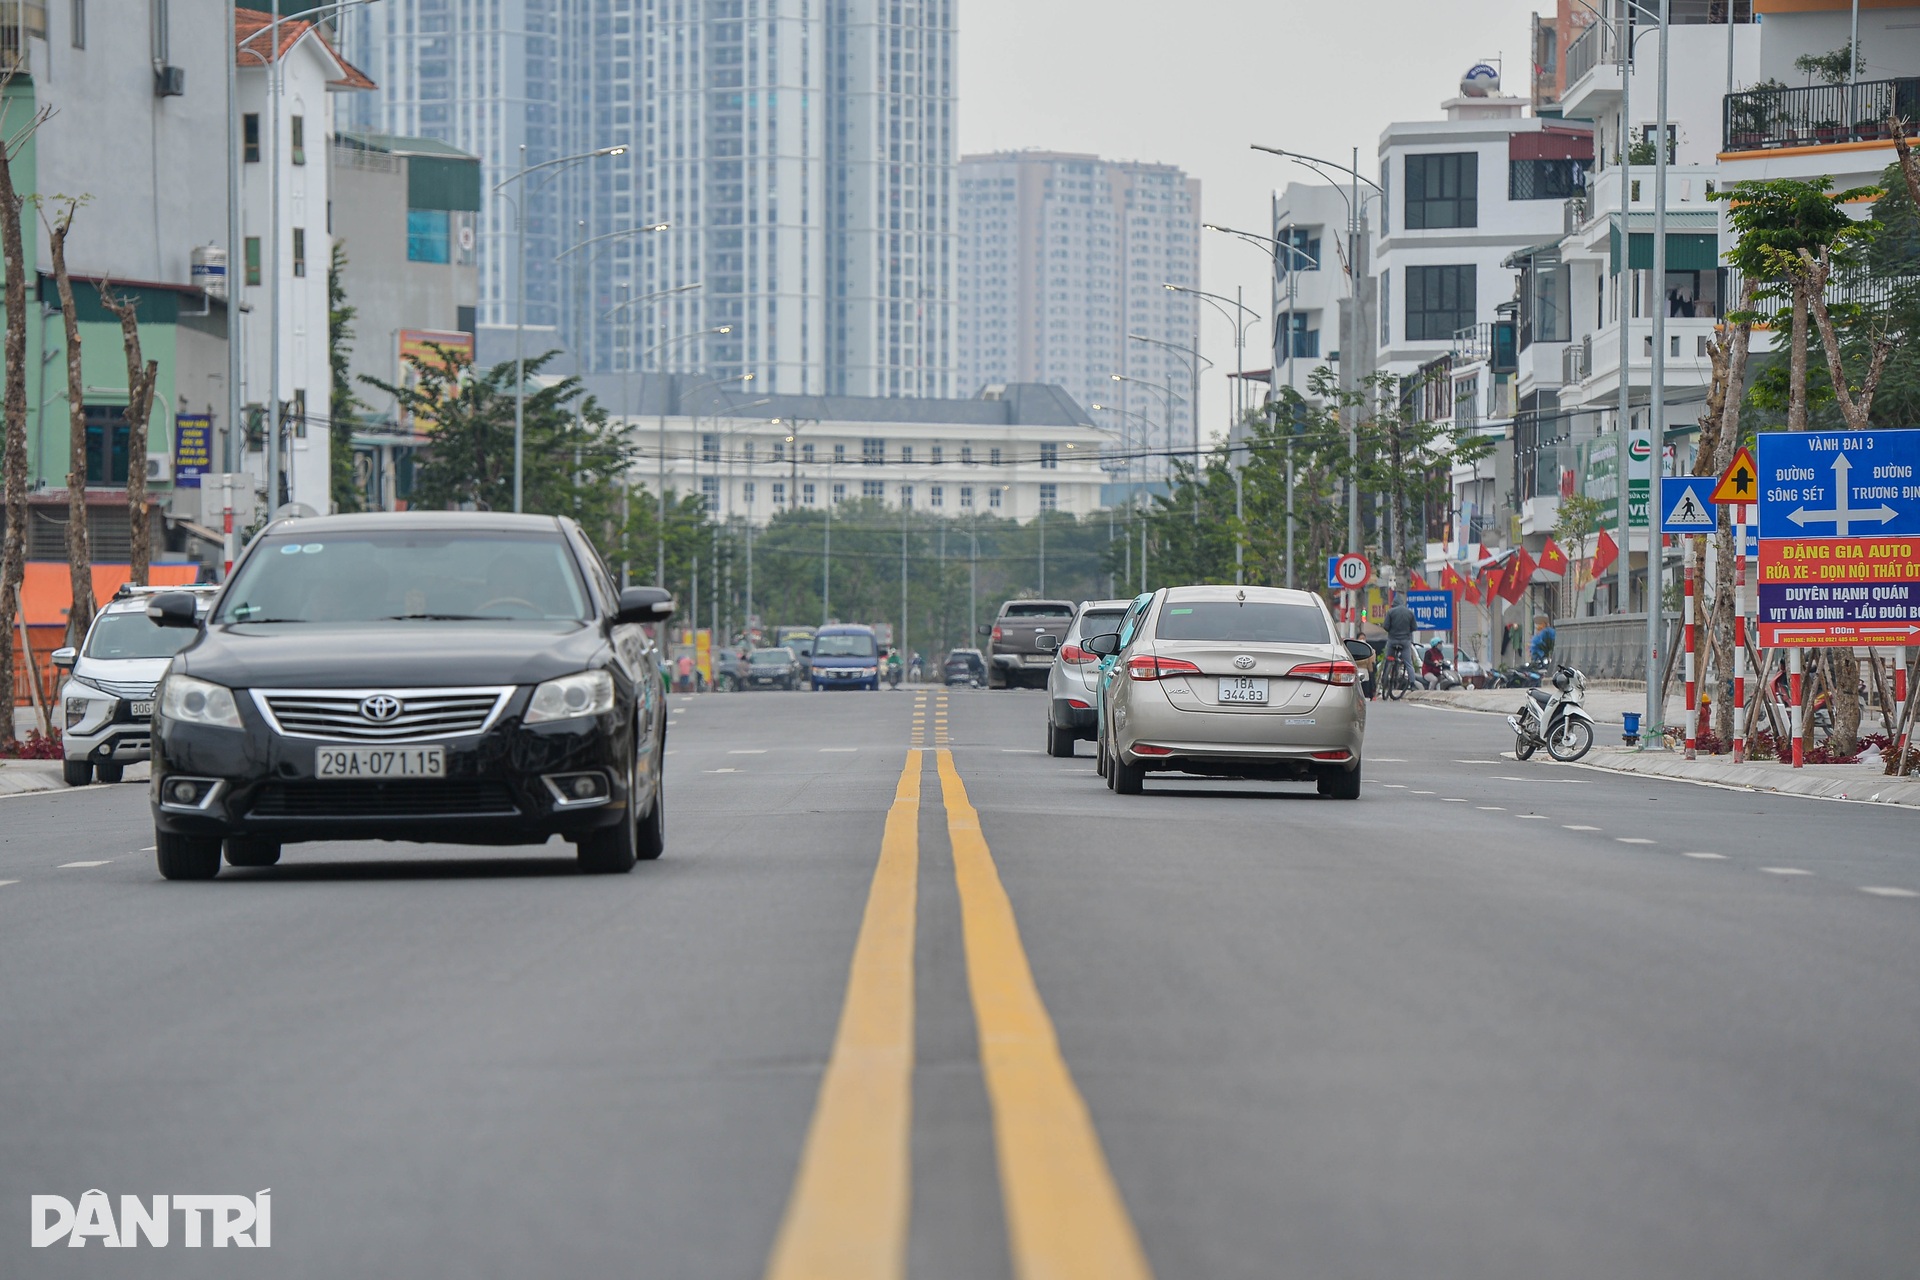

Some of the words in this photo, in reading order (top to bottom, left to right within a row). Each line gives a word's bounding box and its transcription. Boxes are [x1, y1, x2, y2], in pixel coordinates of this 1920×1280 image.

[1808, 436, 1838, 451] VÀNH
[1843, 438, 1862, 450] ĐAI
[1866, 438, 1874, 450] 3
[1776, 465, 1814, 481] ĐƯỜNG
[1873, 462, 1912, 478] ĐƯỜNG
[1767, 487, 1798, 502] SÔNG
[1802, 486, 1824, 501] SÉT
[1852, 486, 1898, 499] TRƯƠNG
[1783, 544, 1830, 562] ĐẶNG
[1836, 545, 1864, 558] GIA
[1868, 544, 1912, 558] AUTO
[1343, 564, 1356, 578] 10
[1766, 562, 1790, 579] RỬA
[1794, 566, 1809, 579] XE
[1820, 565, 1845, 581] DỌN
[1849, 562, 1869, 580] NỘI
[1873, 560, 1902, 578] THẤT
[1786, 586, 1829, 601] DUYÊN
[1832, 587, 1869, 602] HẠNH
[1872, 585, 1908, 601] QUÁN
[1417, 607, 1431, 621] THỌ
[1433, 602, 1447, 618] CHỈ
[1770, 608, 1787, 622] VỊT
[1790, 606, 1813, 620] VÂN
[1816, 605, 1844, 619] ĐÌNH
[1855, 602, 1876, 619] LẨU
[1879, 604, 1906, 619] ĐUÔI
[1234, 678, 1254, 689] 18A
[1224, 690, 1263, 700] 344.83
[322, 752, 440, 774] 29A-071.15
